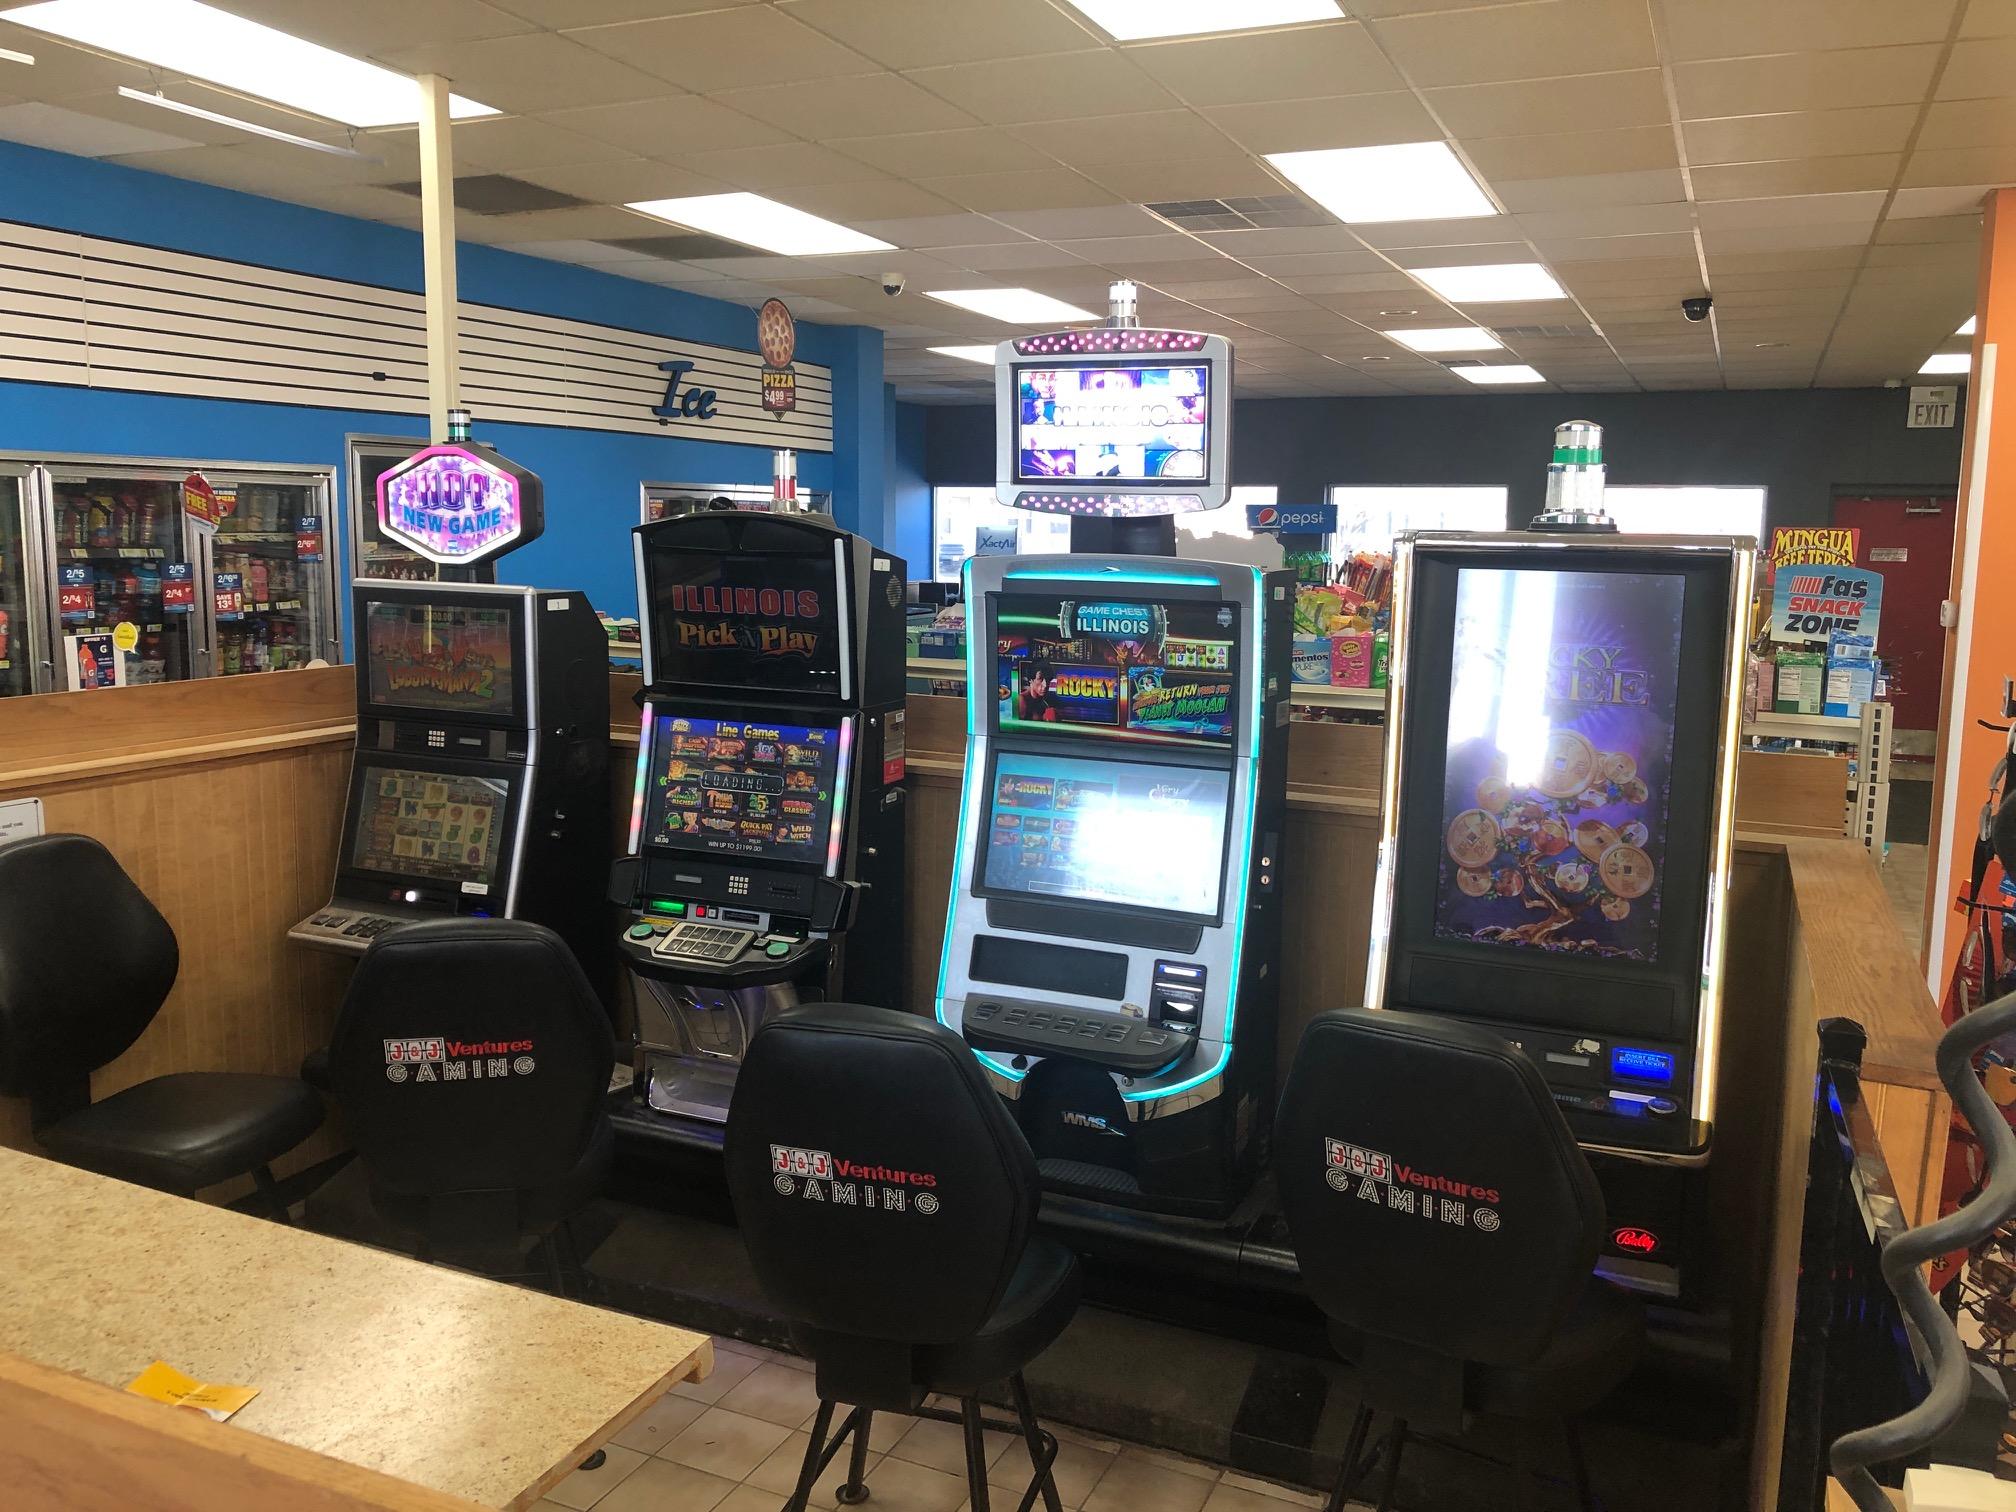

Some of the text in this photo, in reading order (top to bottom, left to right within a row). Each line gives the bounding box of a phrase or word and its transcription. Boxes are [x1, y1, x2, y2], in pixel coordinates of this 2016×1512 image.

[651, 360, 718, 420] Ice
[763, 373, 794, 388] PIZZA
[1914, 404, 1949, 426] EXIT
[415, 469, 490, 510] HOT
[403, 508, 502, 534] NEW GAME
[1281, 510, 1325, 527] pepsi
[979, 535, 1016, 550] XactAir
[1772, 528, 1855, 563] MINGUA
[672, 584, 820, 618] ILLINOIS
[1077, 605, 1148, 617] GAME CHEST
[1789, 596, 1865, 617] SNACK
[1076, 617, 1150, 635] ILLINOIS
[1784, 614, 1860, 635] ZONE
[678, 620, 737, 648] Pick
[759, 625, 819, 658] Play
[1291, 654, 1329, 664] mentos
[1056, 674, 1116, 699] ROCKY
[1158, 684, 1198, 703] RETURN
[1175, 697, 1227, 720] MOOLAH
[716, 722, 780, 741] Line Games
[740, 820, 761, 830] QUICK
[761, 821, 773, 832] PAY
[791, 824, 812, 833] WILD
[708, 840, 719, 848] WIN
[727, 842, 735, 850] TO
[446, 1039, 534, 1057] Ventures
[1062, 1111, 1107, 1130] WMS
[833, 1158, 937, 1187] Ventures
[1394, 1163, 1500, 1204] Ventures
[1616, 1231, 1655, 1251] Bally
